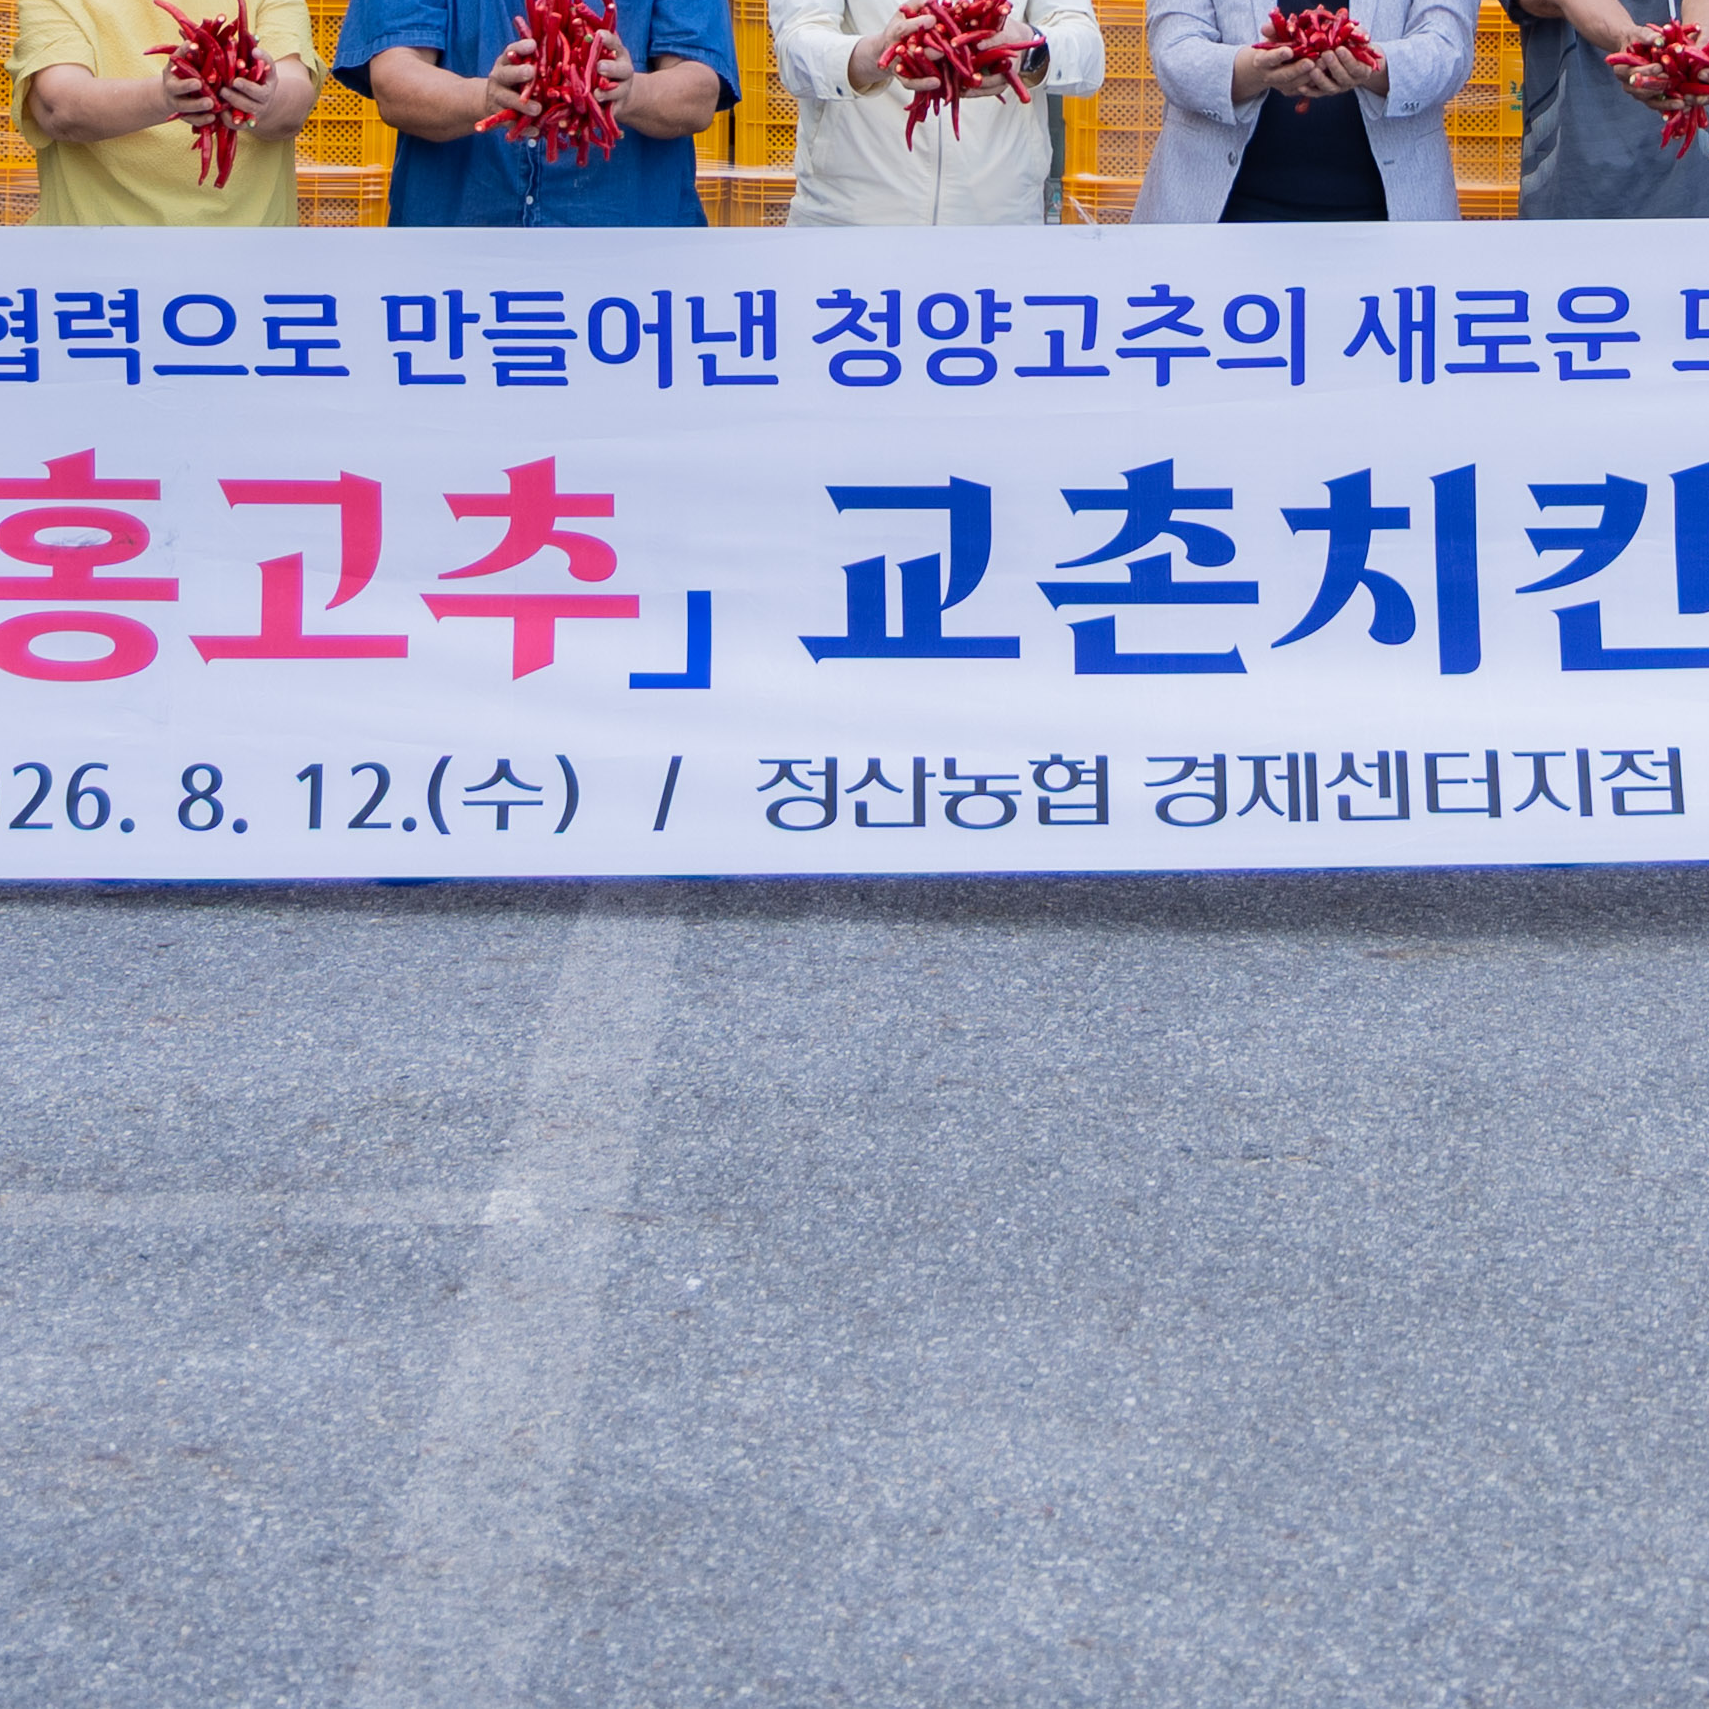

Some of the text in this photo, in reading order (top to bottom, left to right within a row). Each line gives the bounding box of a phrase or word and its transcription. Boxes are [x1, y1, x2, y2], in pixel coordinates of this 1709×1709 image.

[380, 288, 780, 389] 만들어낸
[812, 284, 1306, 388] 청양고추의
[1343, 285, 1641, 384] 새로운
[177, 762, 249, 834] 8.
[293, 754, 581, 835] 12.(수)
[652, 755, 685, 833] /
[755, 753, 1111, 831] 정산농협
[1143, 748, 1687, 828] 경제센터지점
